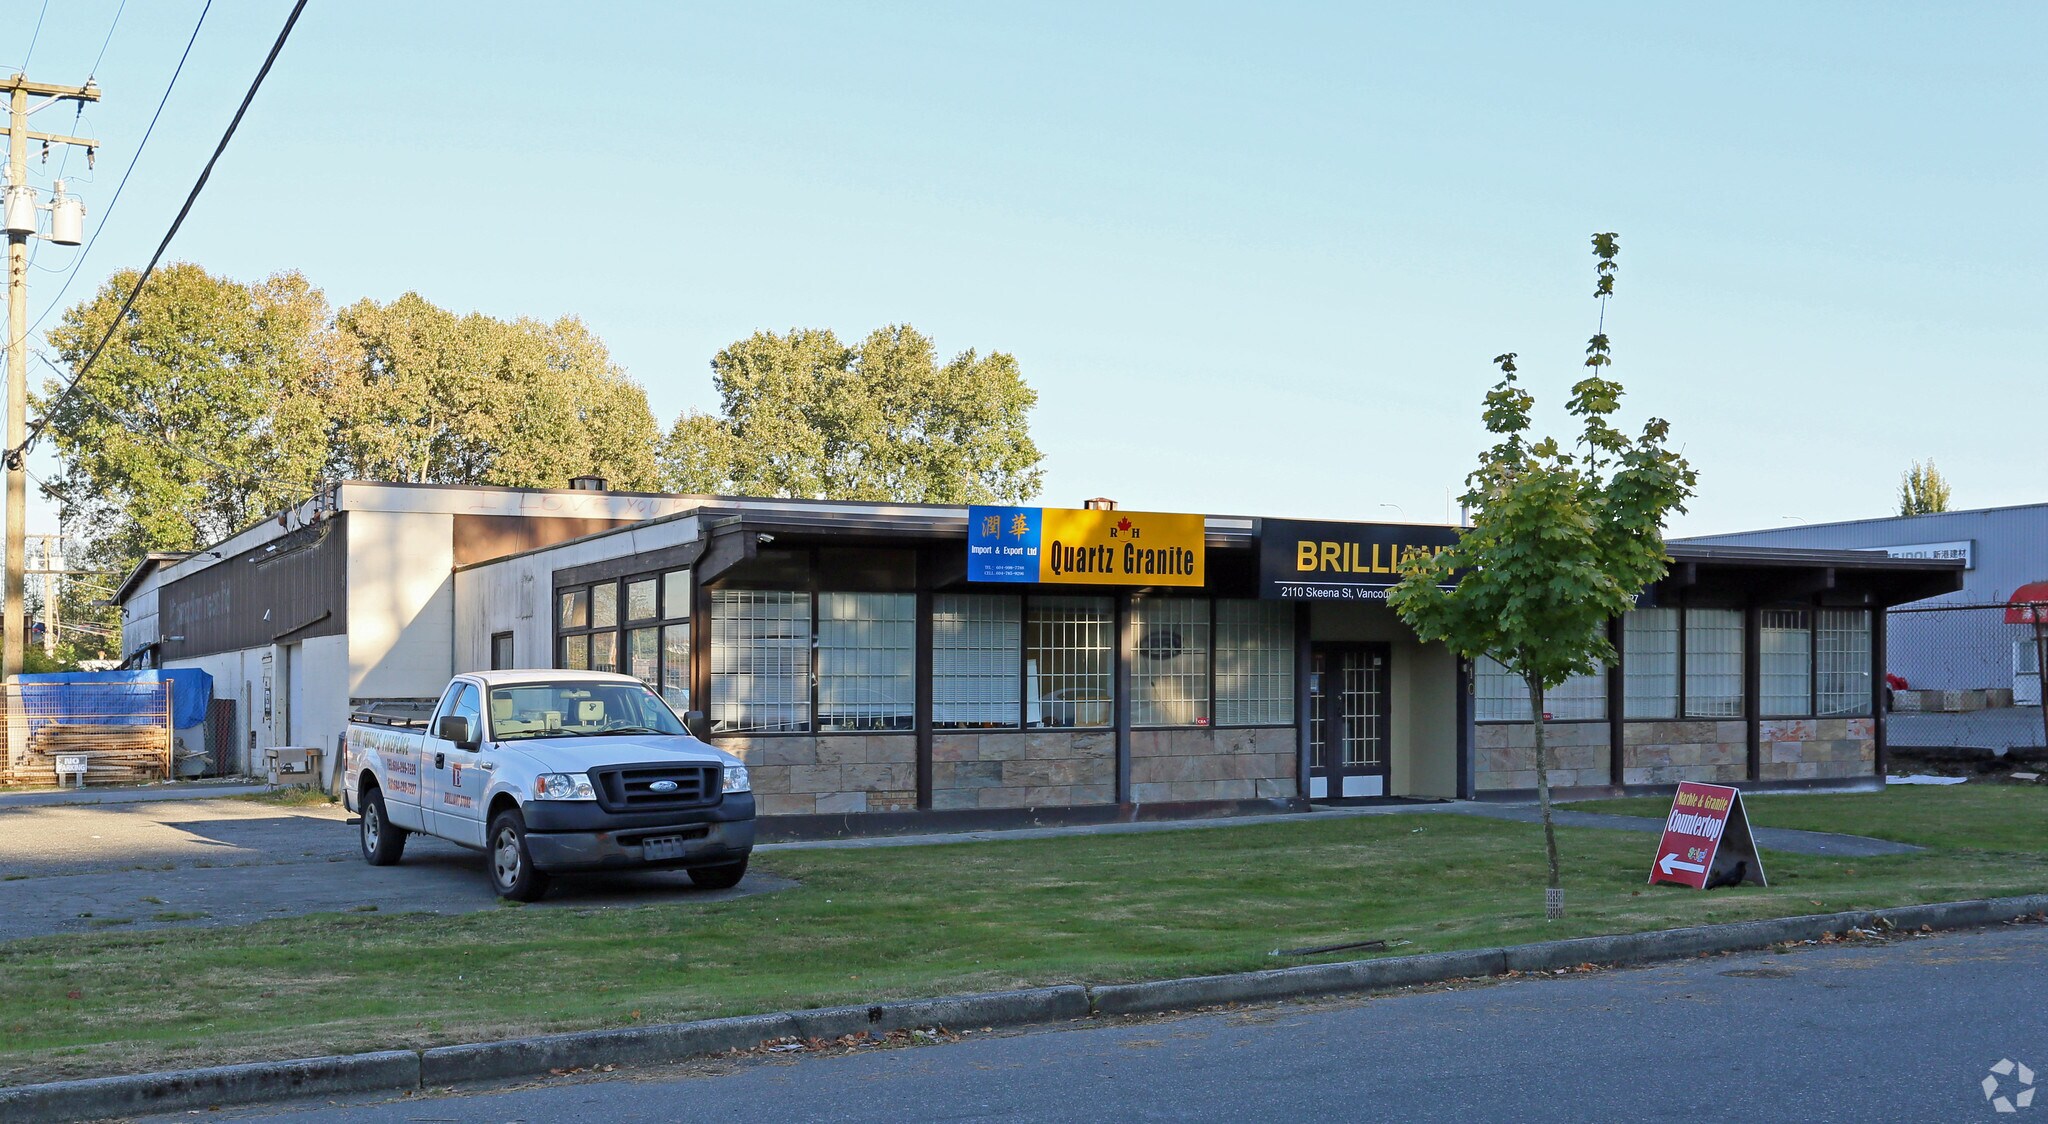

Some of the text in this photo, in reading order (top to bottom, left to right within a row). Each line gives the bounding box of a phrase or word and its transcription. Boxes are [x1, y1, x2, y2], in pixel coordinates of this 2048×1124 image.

[1110, 528, 1140, 539] R H
[971, 545, 1037, 556] Import & Export Ltd
[1051, 540, 1194, 575] Quartz Granite
[1281, 587, 1397, 599] 2110 Skeena St, Vancou
[64, 757, 80, 765] NO
[1678, 792, 1729, 811] Marble & Granite
[1668, 809, 1722, 841] Countertop
